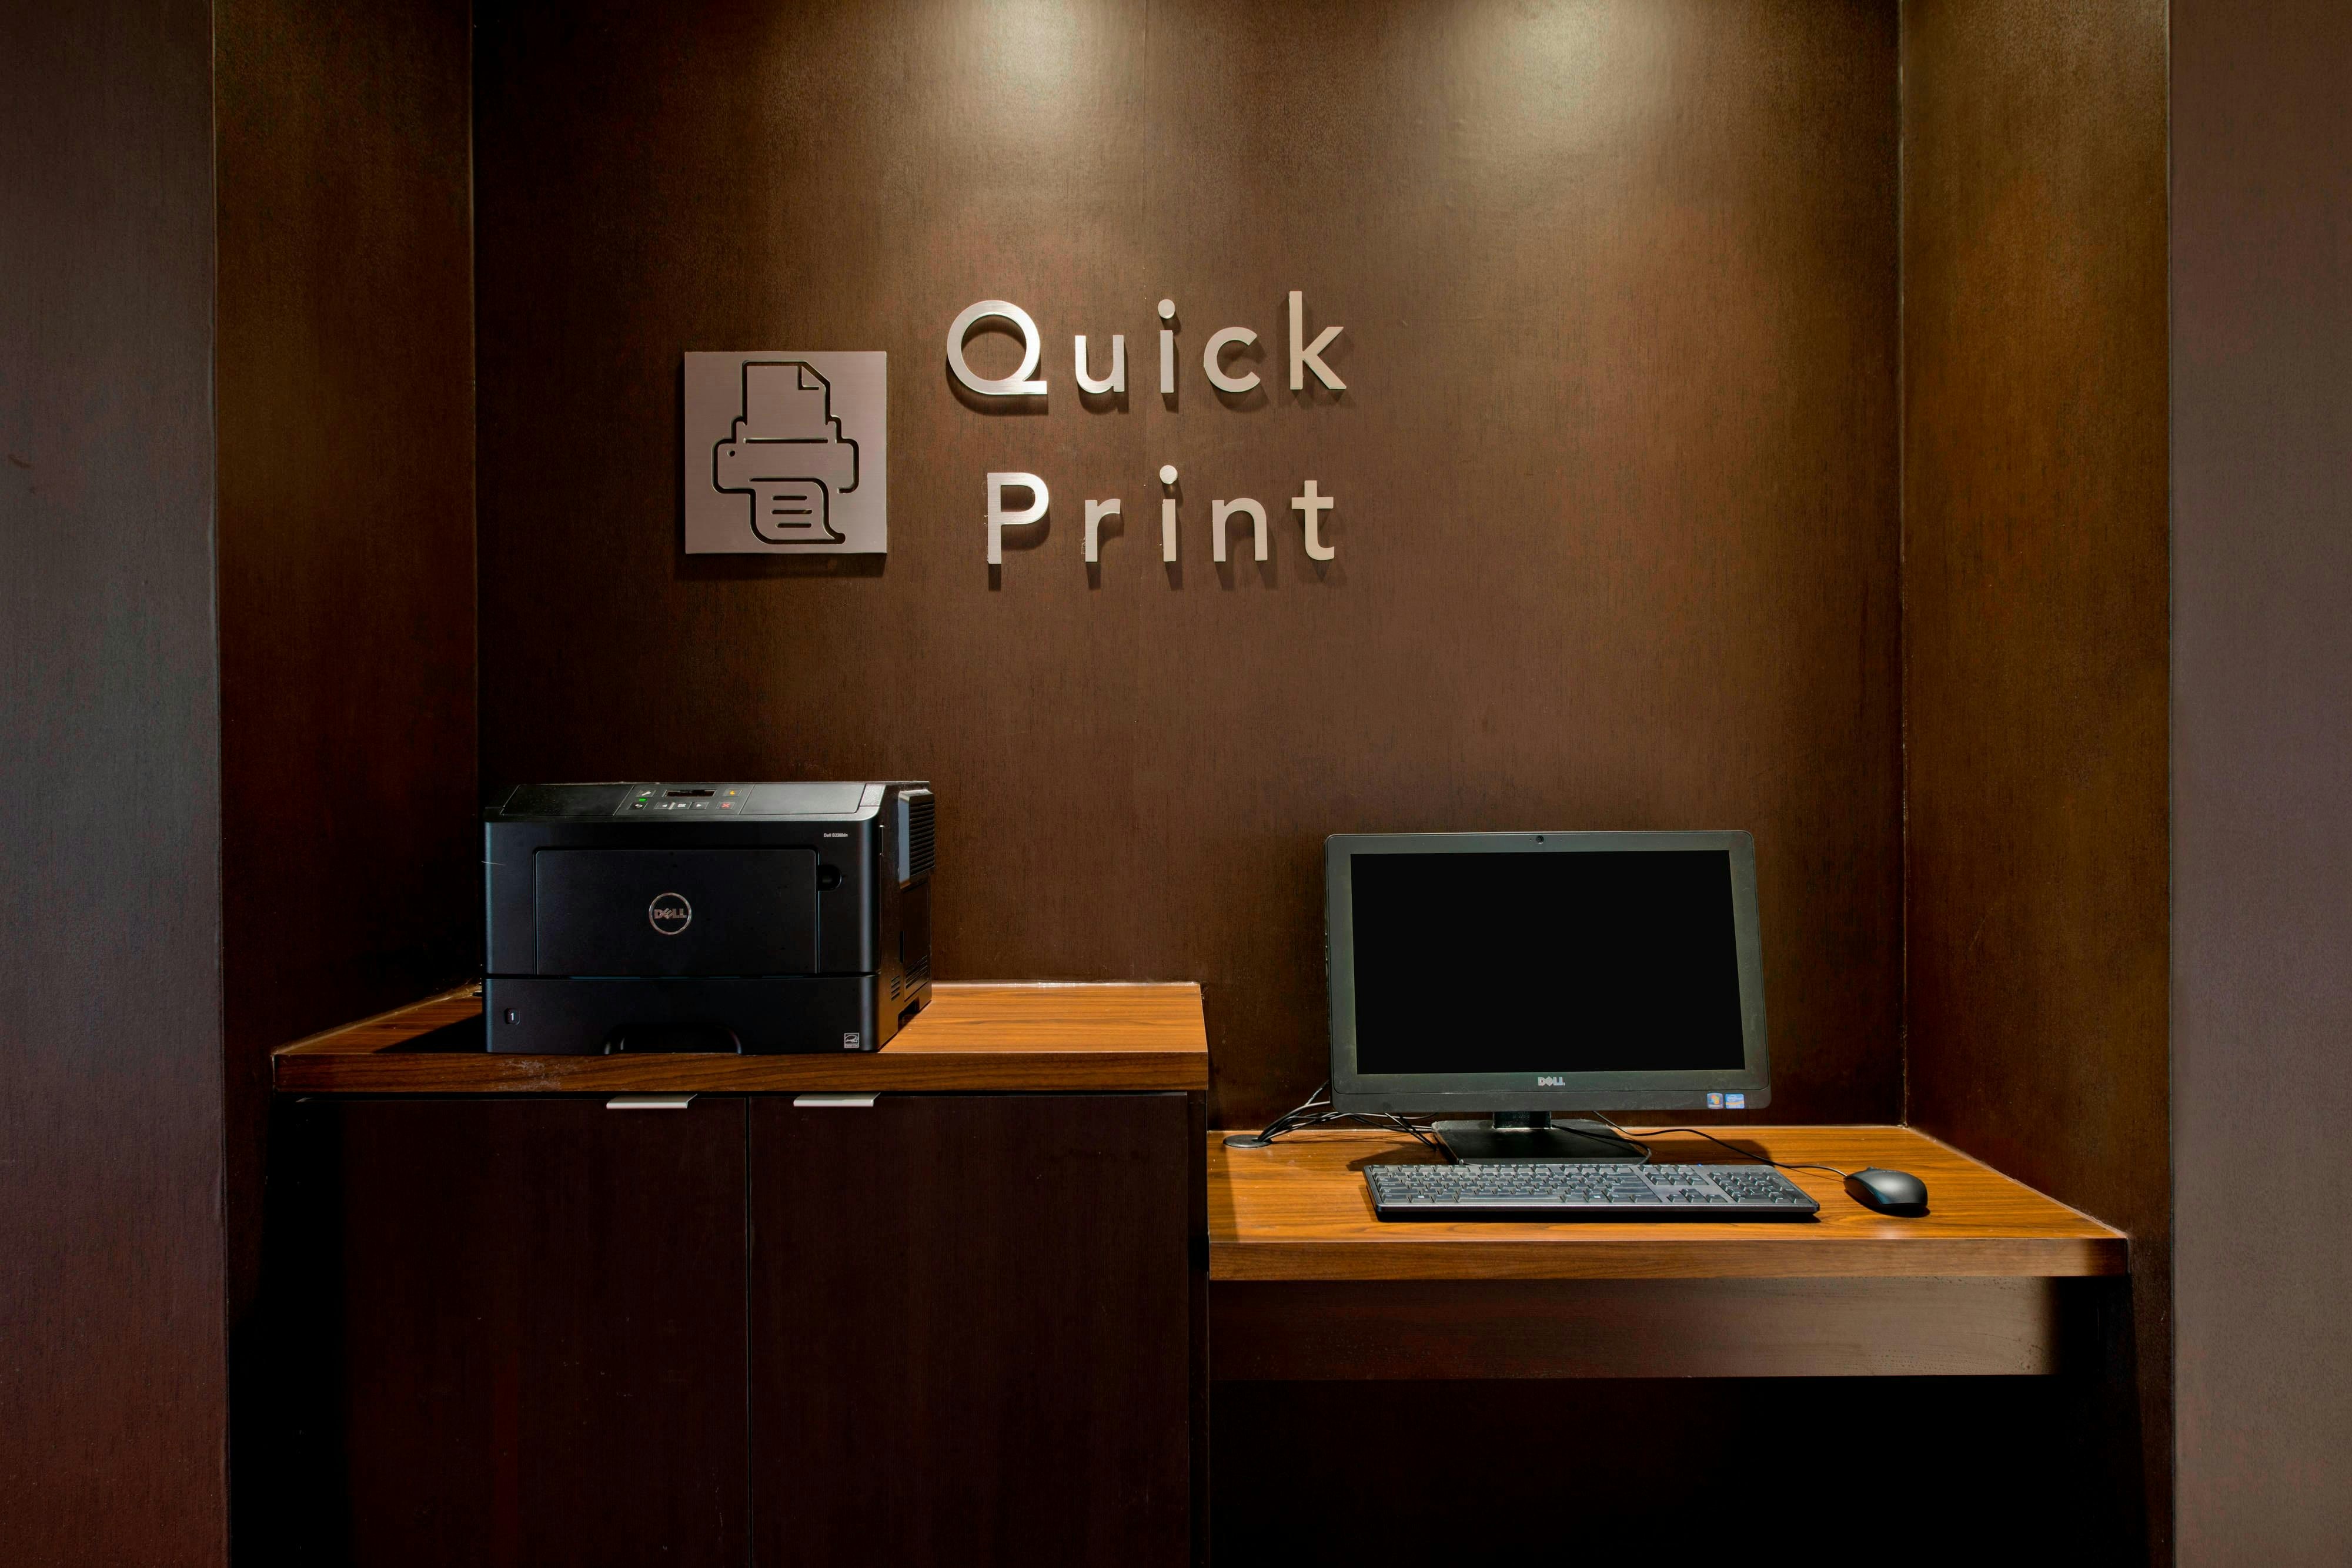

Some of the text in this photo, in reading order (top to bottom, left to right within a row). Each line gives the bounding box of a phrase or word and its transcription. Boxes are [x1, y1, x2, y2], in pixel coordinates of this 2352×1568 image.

[947, 291, 1347, 394] Quick
[985, 465, 1334, 564] Print
[654, 908, 687, 919] DELL
[510, 1012, 514, 1021] 1
[1538, 1076, 1565, 1086] DELL
